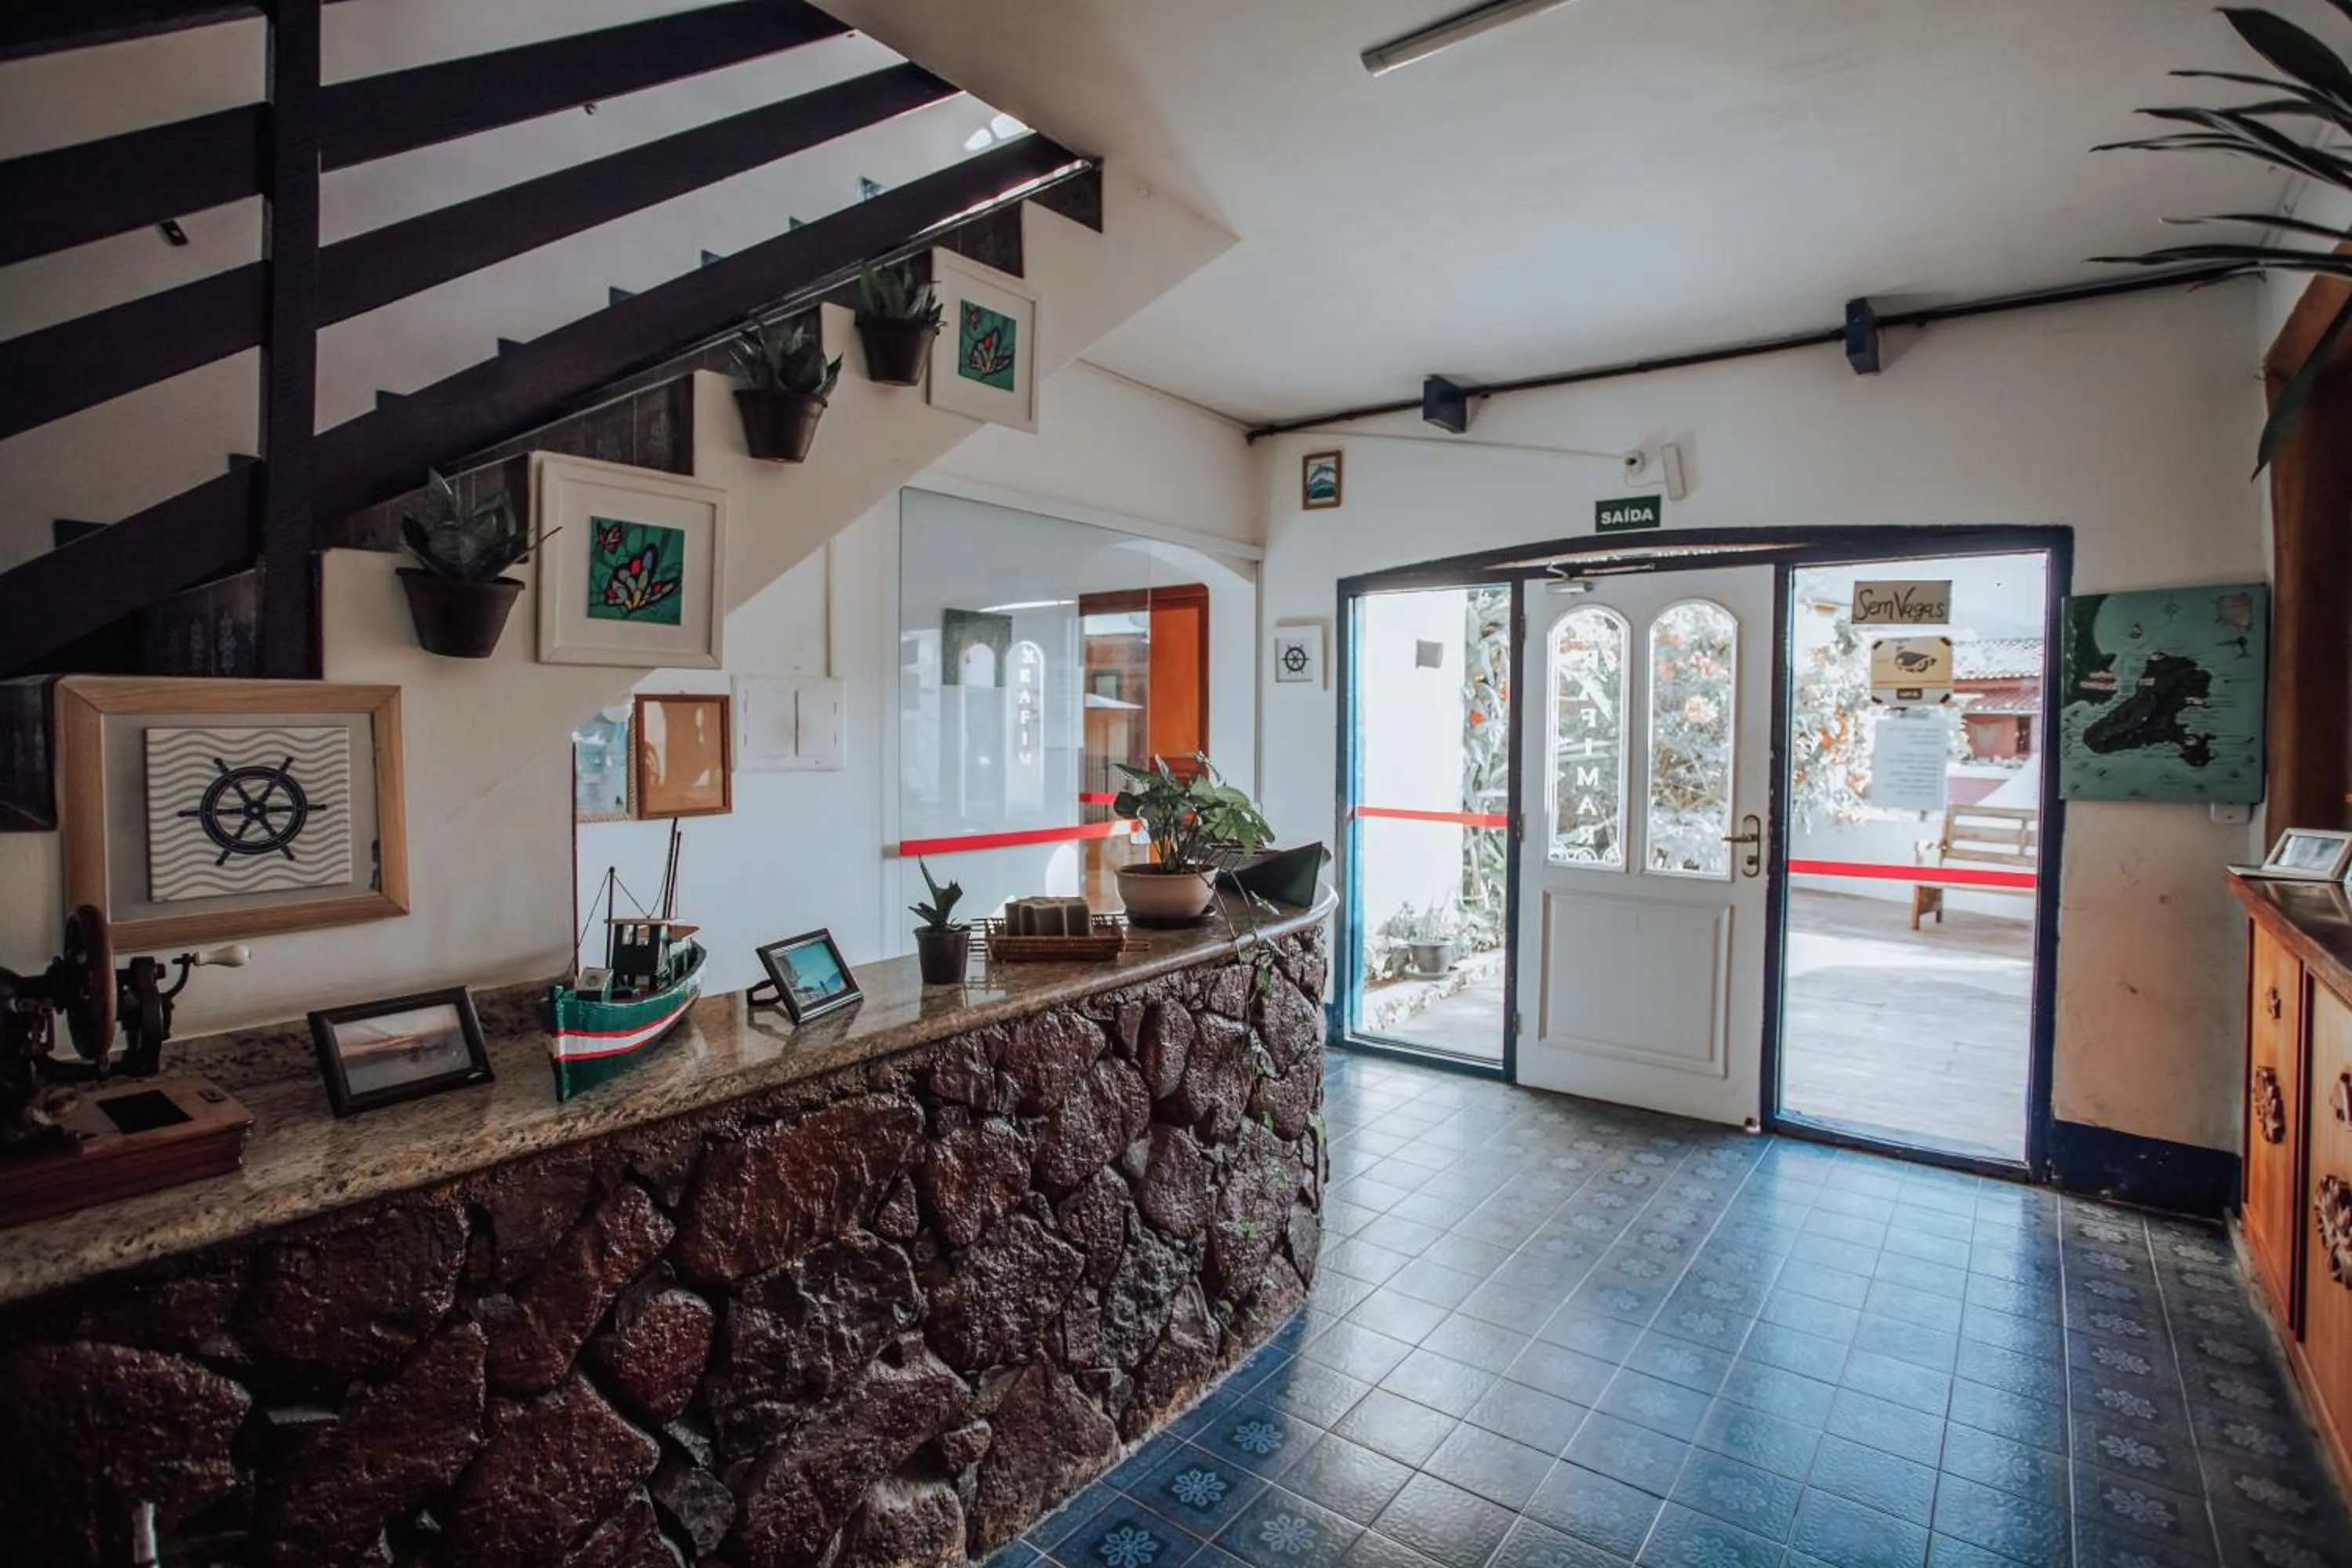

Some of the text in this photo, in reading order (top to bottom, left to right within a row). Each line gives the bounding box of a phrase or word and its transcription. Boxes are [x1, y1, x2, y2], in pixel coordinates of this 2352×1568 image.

[1600, 506, 1653, 524] SAÍDA
[1853, 586, 1945, 622] Sem Vagas
